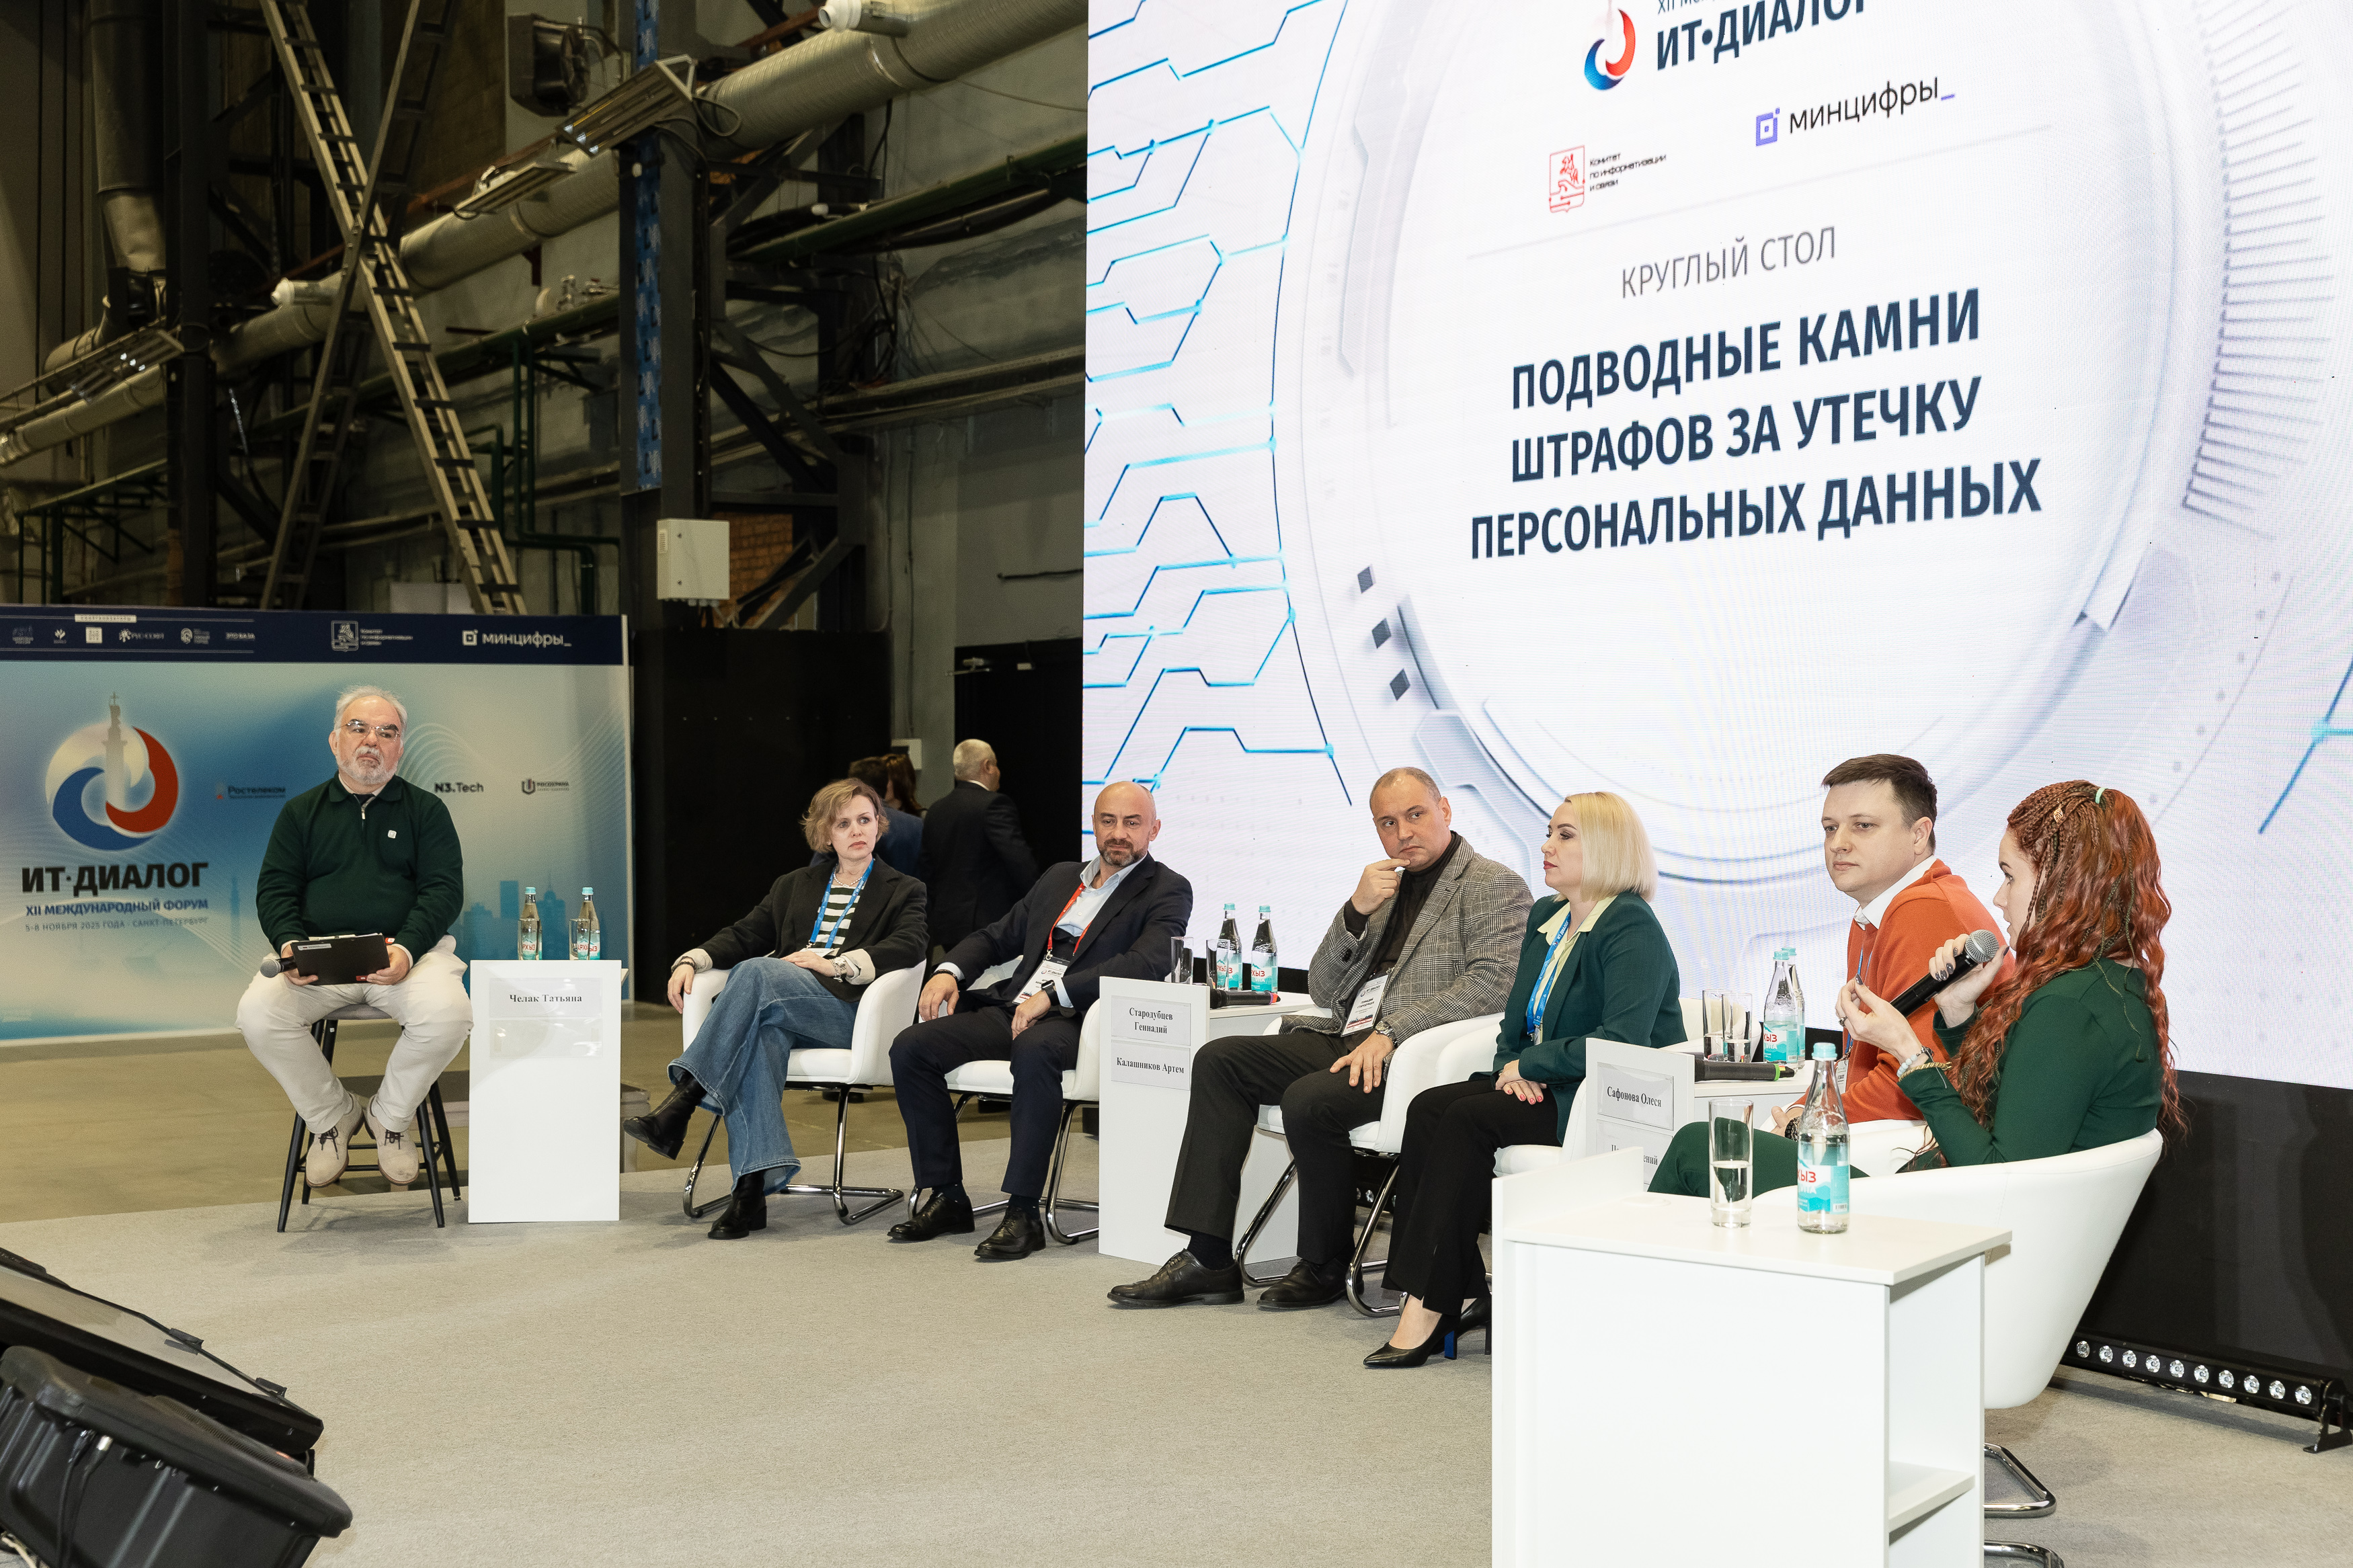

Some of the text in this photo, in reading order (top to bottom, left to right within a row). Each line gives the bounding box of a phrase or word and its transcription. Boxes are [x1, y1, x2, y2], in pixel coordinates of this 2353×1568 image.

[1589, 152, 1621, 167] Комитет
[1622, 226, 1836, 298] КРУГЛЫЙ СТОЛ
[1512, 288, 1980, 412] ПОДВОДНЫЕ КАМНИ
[1512, 375, 1983, 483] ШТРАФОВ ЗА УТЕЧКУ
[1471, 457, 2042, 560] ПЕРСОНАЛЬНЫХ ДАННЫХ
[434, 782, 484, 793] N3.Tech
[44, 898, 160, 916] МЕЖДУНАРОДНЫЙ
[163, 898, 208, 911] ФОРУМ
[42, 921, 77, 931] НОЯБРЯ
[102, 920, 126, 929] ГОДА
[510, 994, 582, 1002] Челак Татьяна
[1129, 1007, 1173, 1020] Стародубцев
[1135, 1022, 1167, 1034] Геннадий
[1764, 1034, 1778, 1042] ХЫЗ
[1117, 1057, 1184, 1074] Калашников Артем
[1607, 1086, 1662, 1107] Сафонова Олеся
[1644, 1155, 1658, 1165] ений
[1798, 1169, 1817, 1183] ХЫЗ
